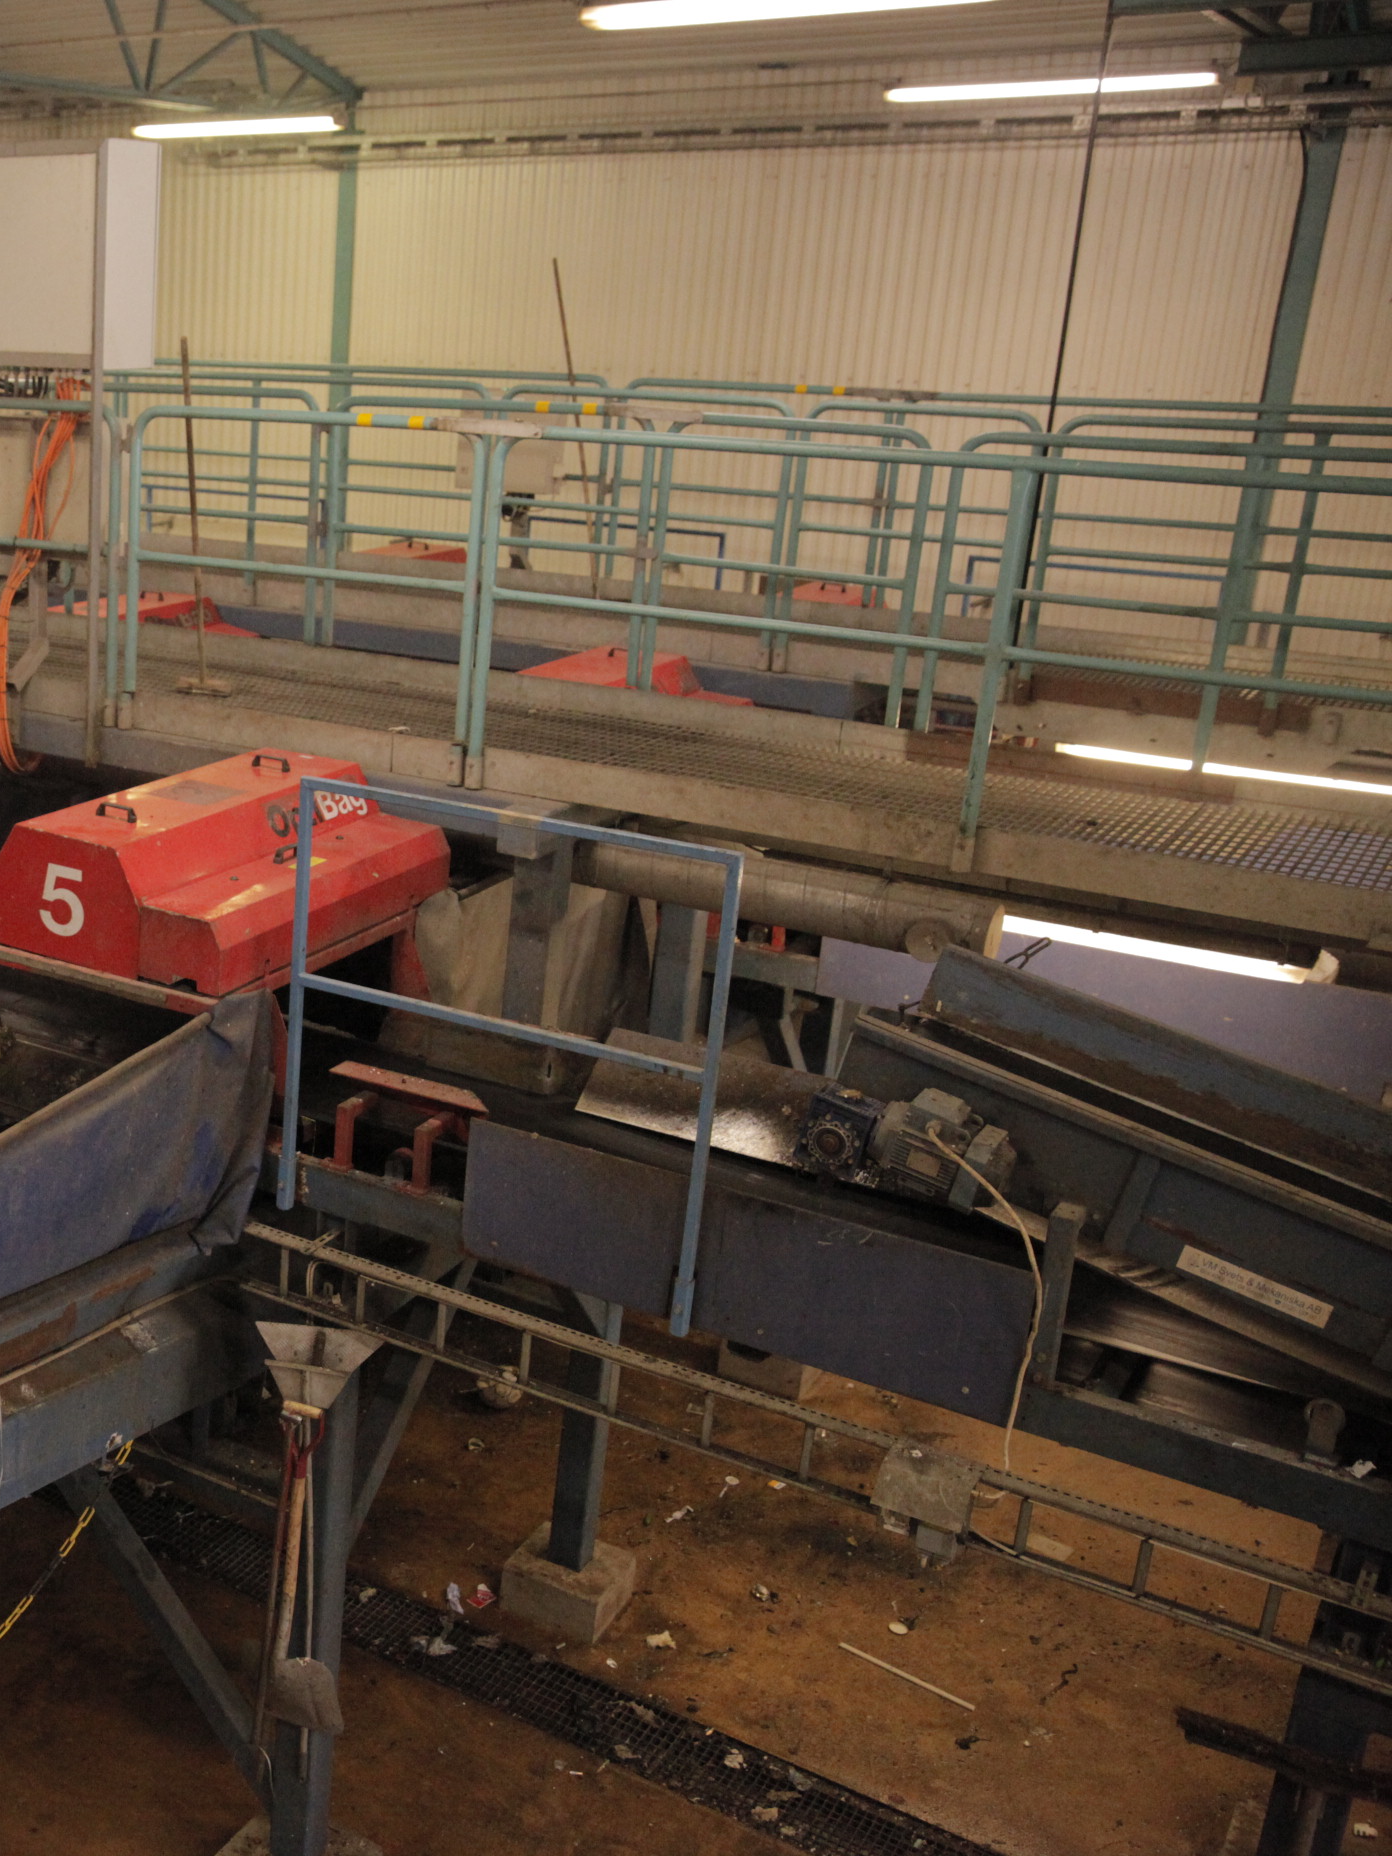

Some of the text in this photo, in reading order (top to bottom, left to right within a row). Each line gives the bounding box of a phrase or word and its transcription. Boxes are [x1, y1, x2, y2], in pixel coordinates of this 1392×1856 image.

[39, 862, 85, 937] 5
[1203, 1258, 1323, 1315] VM Svets & Mekaniska AB
